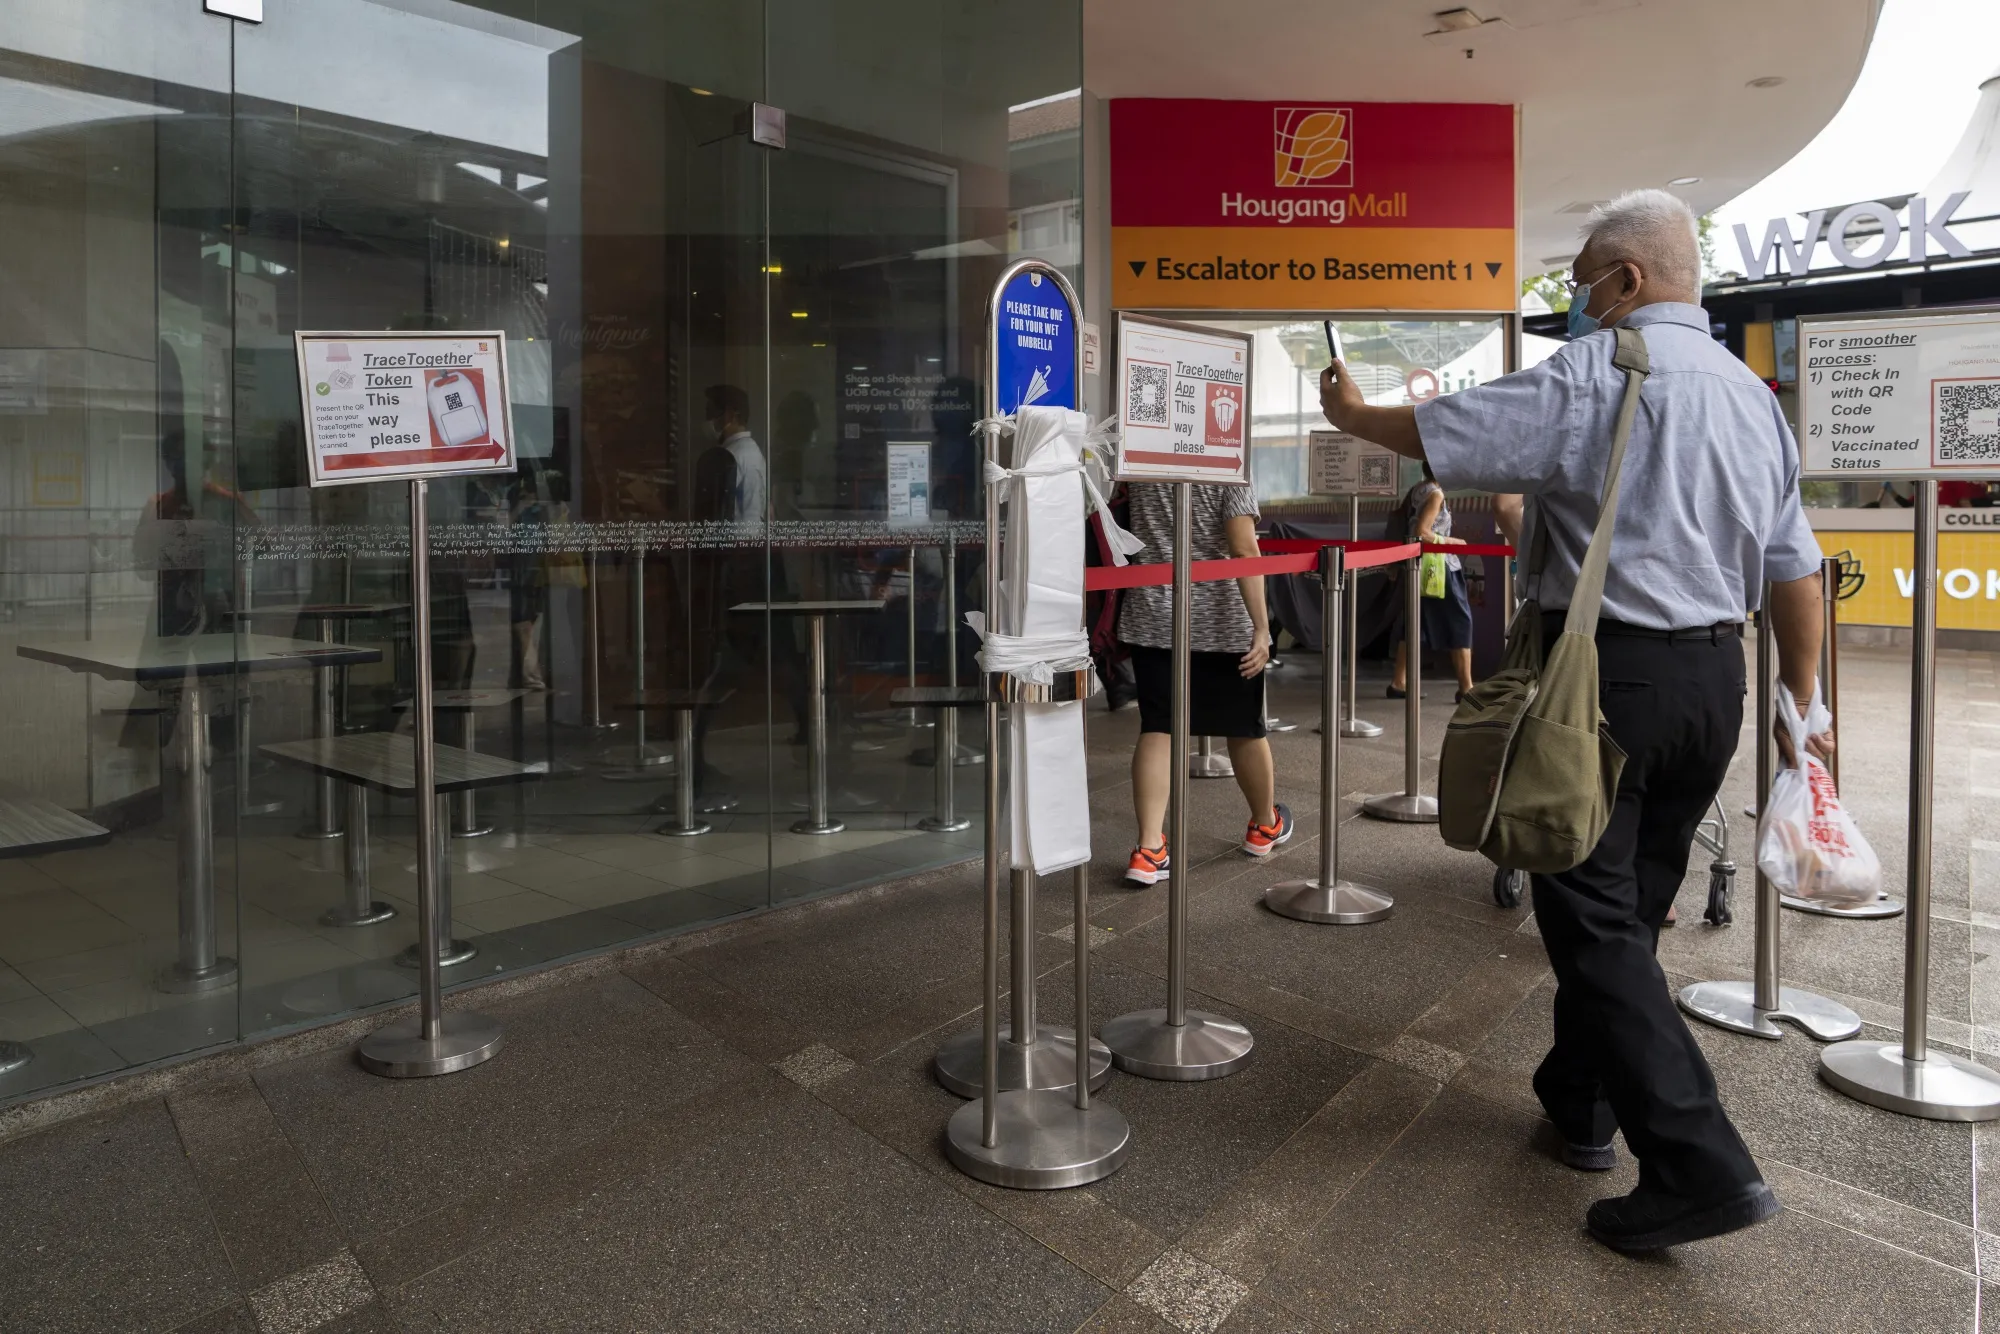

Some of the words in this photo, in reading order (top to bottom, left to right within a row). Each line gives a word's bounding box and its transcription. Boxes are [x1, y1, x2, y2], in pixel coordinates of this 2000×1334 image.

[1732, 190, 1973, 281] WOK
[1157, 256, 1280, 281] Escalator
[1287, 259, 1316, 281] to
[1324, 258, 1457, 281] Basement
[1463, 262, 1473, 281] 1
[1007, 300, 1031, 316] PLEASE
[1033, 305, 1048, 319] TAKE
[1050, 308, 1063, 321] ONE
[1011, 317, 1024, 331] FOR
[1025, 320, 1043, 333] YOUR
[1044, 322, 1059, 336] WET
[1017, 334, 1053, 351] UMBRELLA
[1809, 337, 1835, 348] For
[1839, 333, 1917, 348] smoother
[364, 352, 473, 367] TraceTogether
[1808, 354, 1877, 367] process:
[1176, 360, 1244, 382] TraceTogether
[1809, 371, 1823, 386] 1)
[1831, 369, 1883, 382] Check
[1885, 368, 1900, 380] In
[366, 373, 412, 387] Token
[845, 374, 869, 384] Shop
[887, 374, 922, 385] Shopee
[924, 374, 946, 383] with
[845, 388, 868, 397] UOB
[870, 388, 891, 397] One
[893, 387, 915, 397] Card
[918, 389, 938, 397] now
[941, 387, 959, 397] and
[1175, 380, 1195, 395] App
[1831, 386, 1863, 399] with
[1868, 385, 1894, 398] QR
[366, 393, 400, 406] This
[845, 402, 871, 413] enjoy
[873, 403, 886, 413] up
[888, 402, 899, 411] to
[901, 398, 927, 411] 10%
[1175, 400, 1196, 415] This
[1831, 403, 1872, 416] Code
[318, 423, 364, 431] TraceTogether
[368, 415, 399, 428] way
[1174, 422, 1194, 436] way
[1809, 423, 1823, 438] 2)
[1831, 422, 1875, 435] Show
[371, 432, 421, 449] please
[1174, 439, 1205, 454] please
[1207, 434, 1241, 445] TraceTogether
[1831, 438, 1920, 452] Vaccinated
[1831, 457, 1881, 469] Status
[447, 523, 474, 531] chicken
